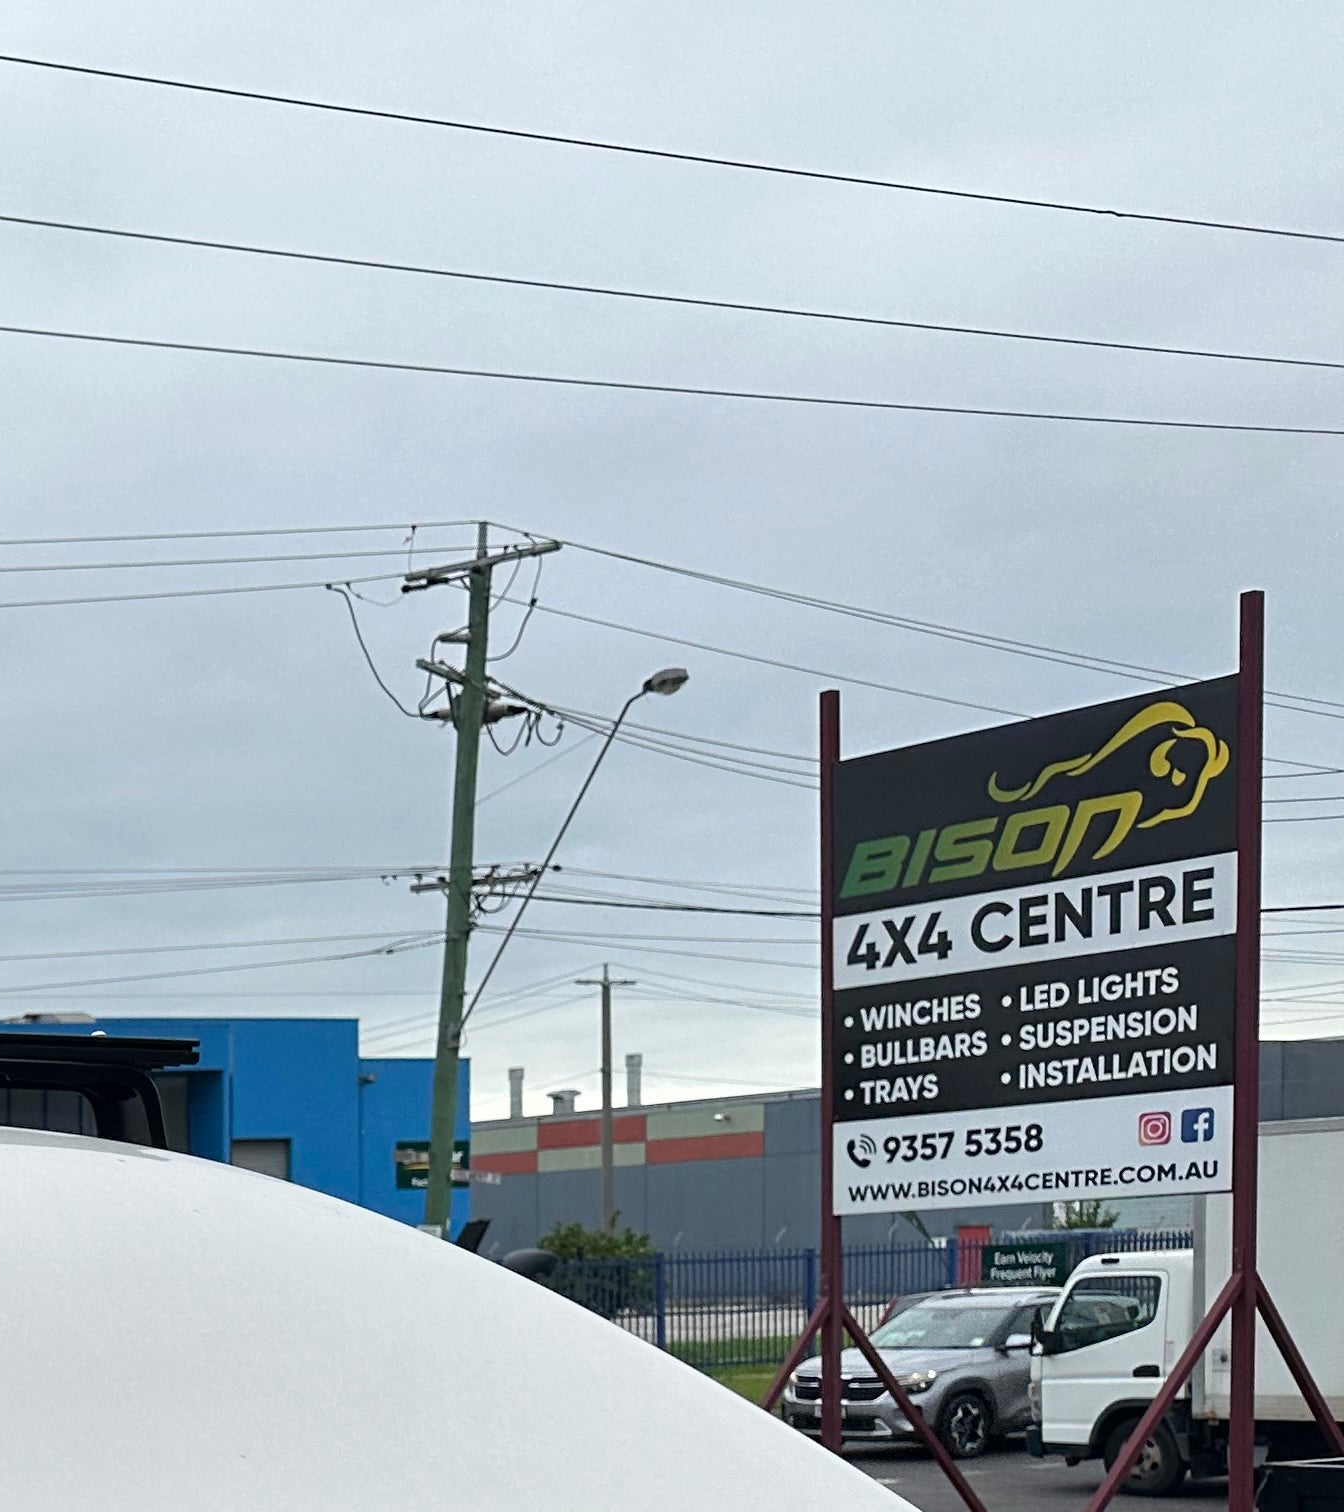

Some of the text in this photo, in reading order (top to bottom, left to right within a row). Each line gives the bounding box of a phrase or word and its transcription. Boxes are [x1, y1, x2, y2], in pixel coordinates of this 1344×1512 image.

[840, 791, 1143, 898] BISON
[847, 867, 1214, 970] 4X4 CENTRE
[1020, 967, 1179, 1012] LED LIGHTS
[860, 994, 981, 1031] WINCHES
[1019, 1004, 1198, 1051] SUSPENSION
[860, 1030, 988, 1069] BULLBARS
[1019, 1043, 1217, 1090] INSTALLATION
[860, 1074, 939, 1105] TRAYS
[883, 1123, 1043, 1163] 9357 5358
[849, 1160, 1218, 1201] WWW.BISON4X4CENTRE.COM.AU
[990, 1265, 1056, 1281] Frequent Flyer
[1017, 1250, 1054, 1266] Velocity
